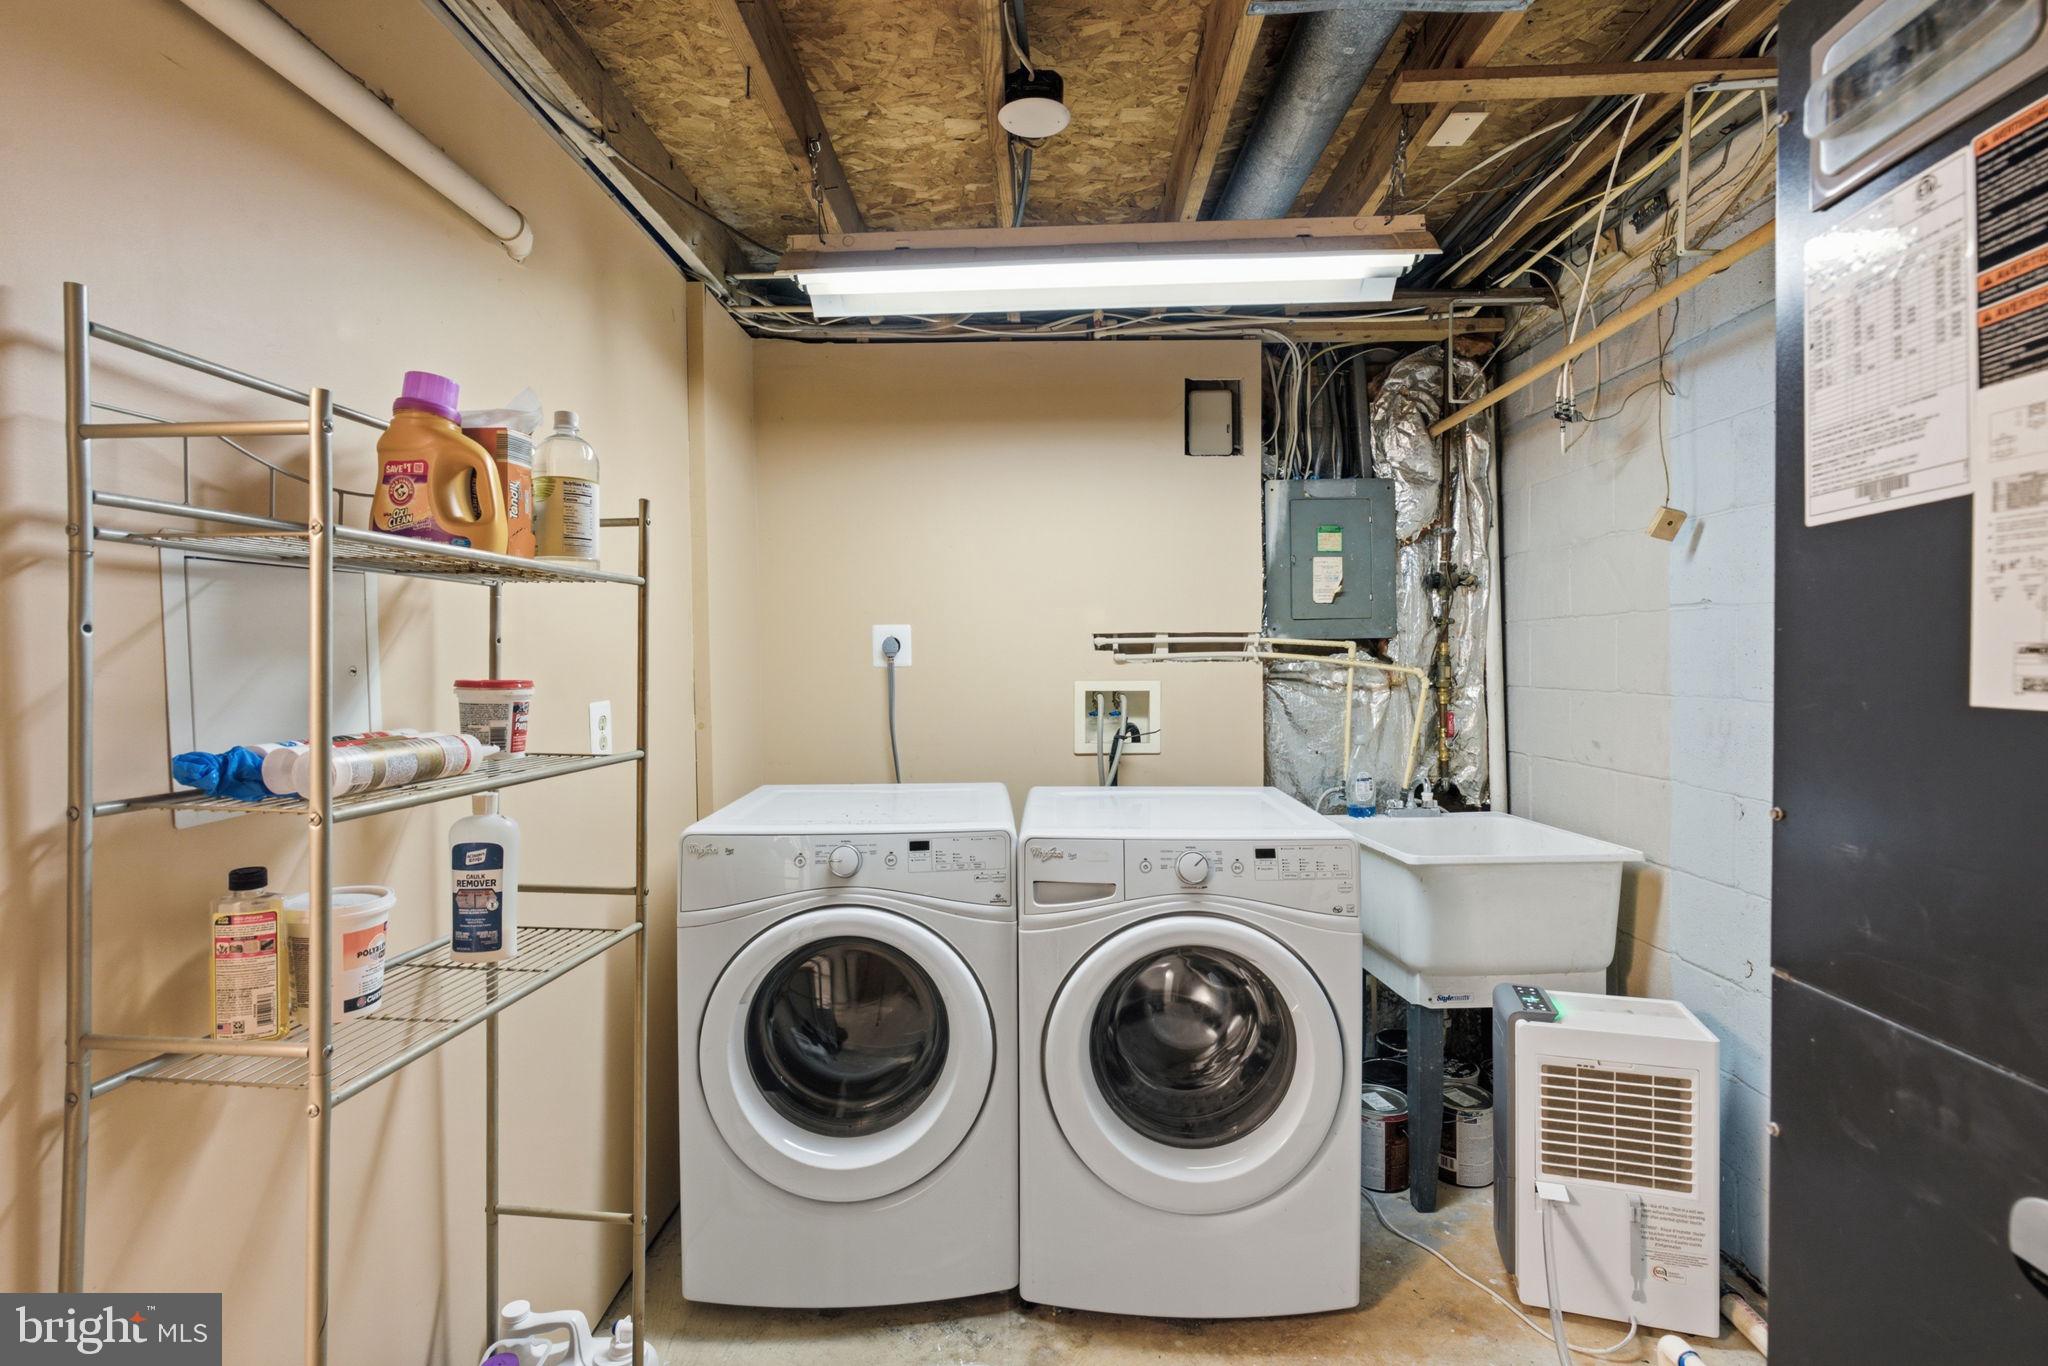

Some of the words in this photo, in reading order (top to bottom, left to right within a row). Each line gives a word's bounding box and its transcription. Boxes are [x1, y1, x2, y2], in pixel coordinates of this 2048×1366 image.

[386, 464, 403, 473] SAVE
[403, 463, 411, 473] $1
[393, 508, 408, 518] OXI
[388, 514, 413, 528] CLEAN
[456, 879, 497, 888] REMOVER
